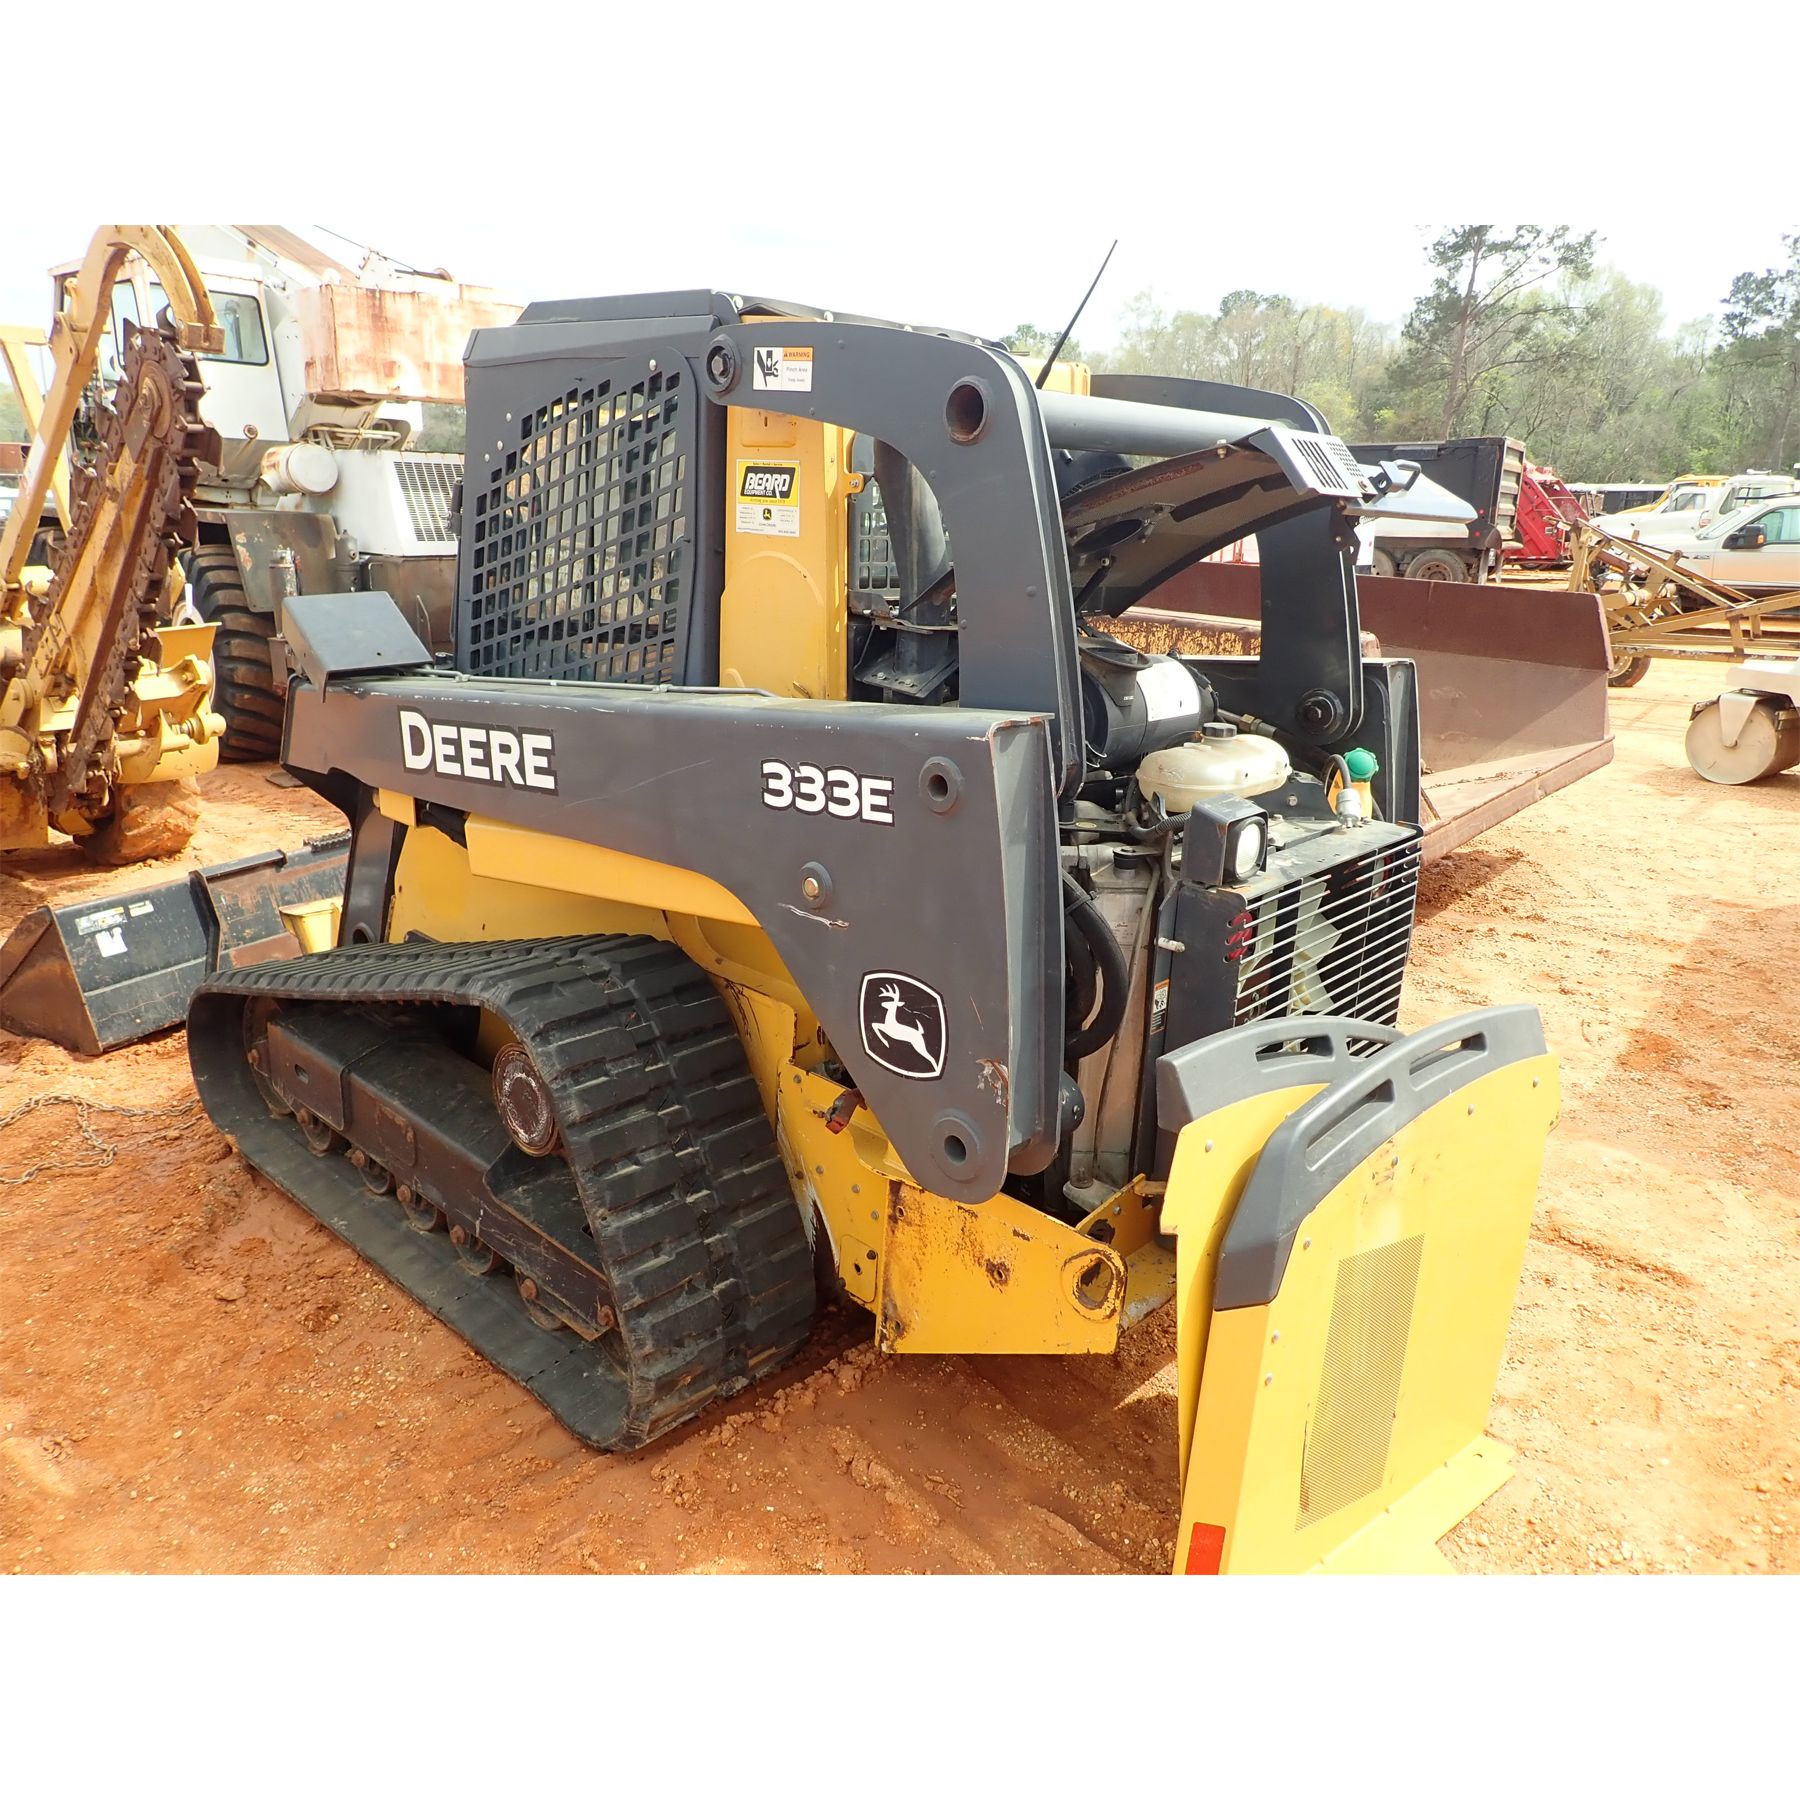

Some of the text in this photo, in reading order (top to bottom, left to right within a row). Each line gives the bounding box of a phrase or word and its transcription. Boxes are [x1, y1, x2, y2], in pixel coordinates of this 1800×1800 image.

[744, 472, 790, 499] BEARD
[400, 710, 556, 789] DEERE
[762, 761, 894, 823] 333E
